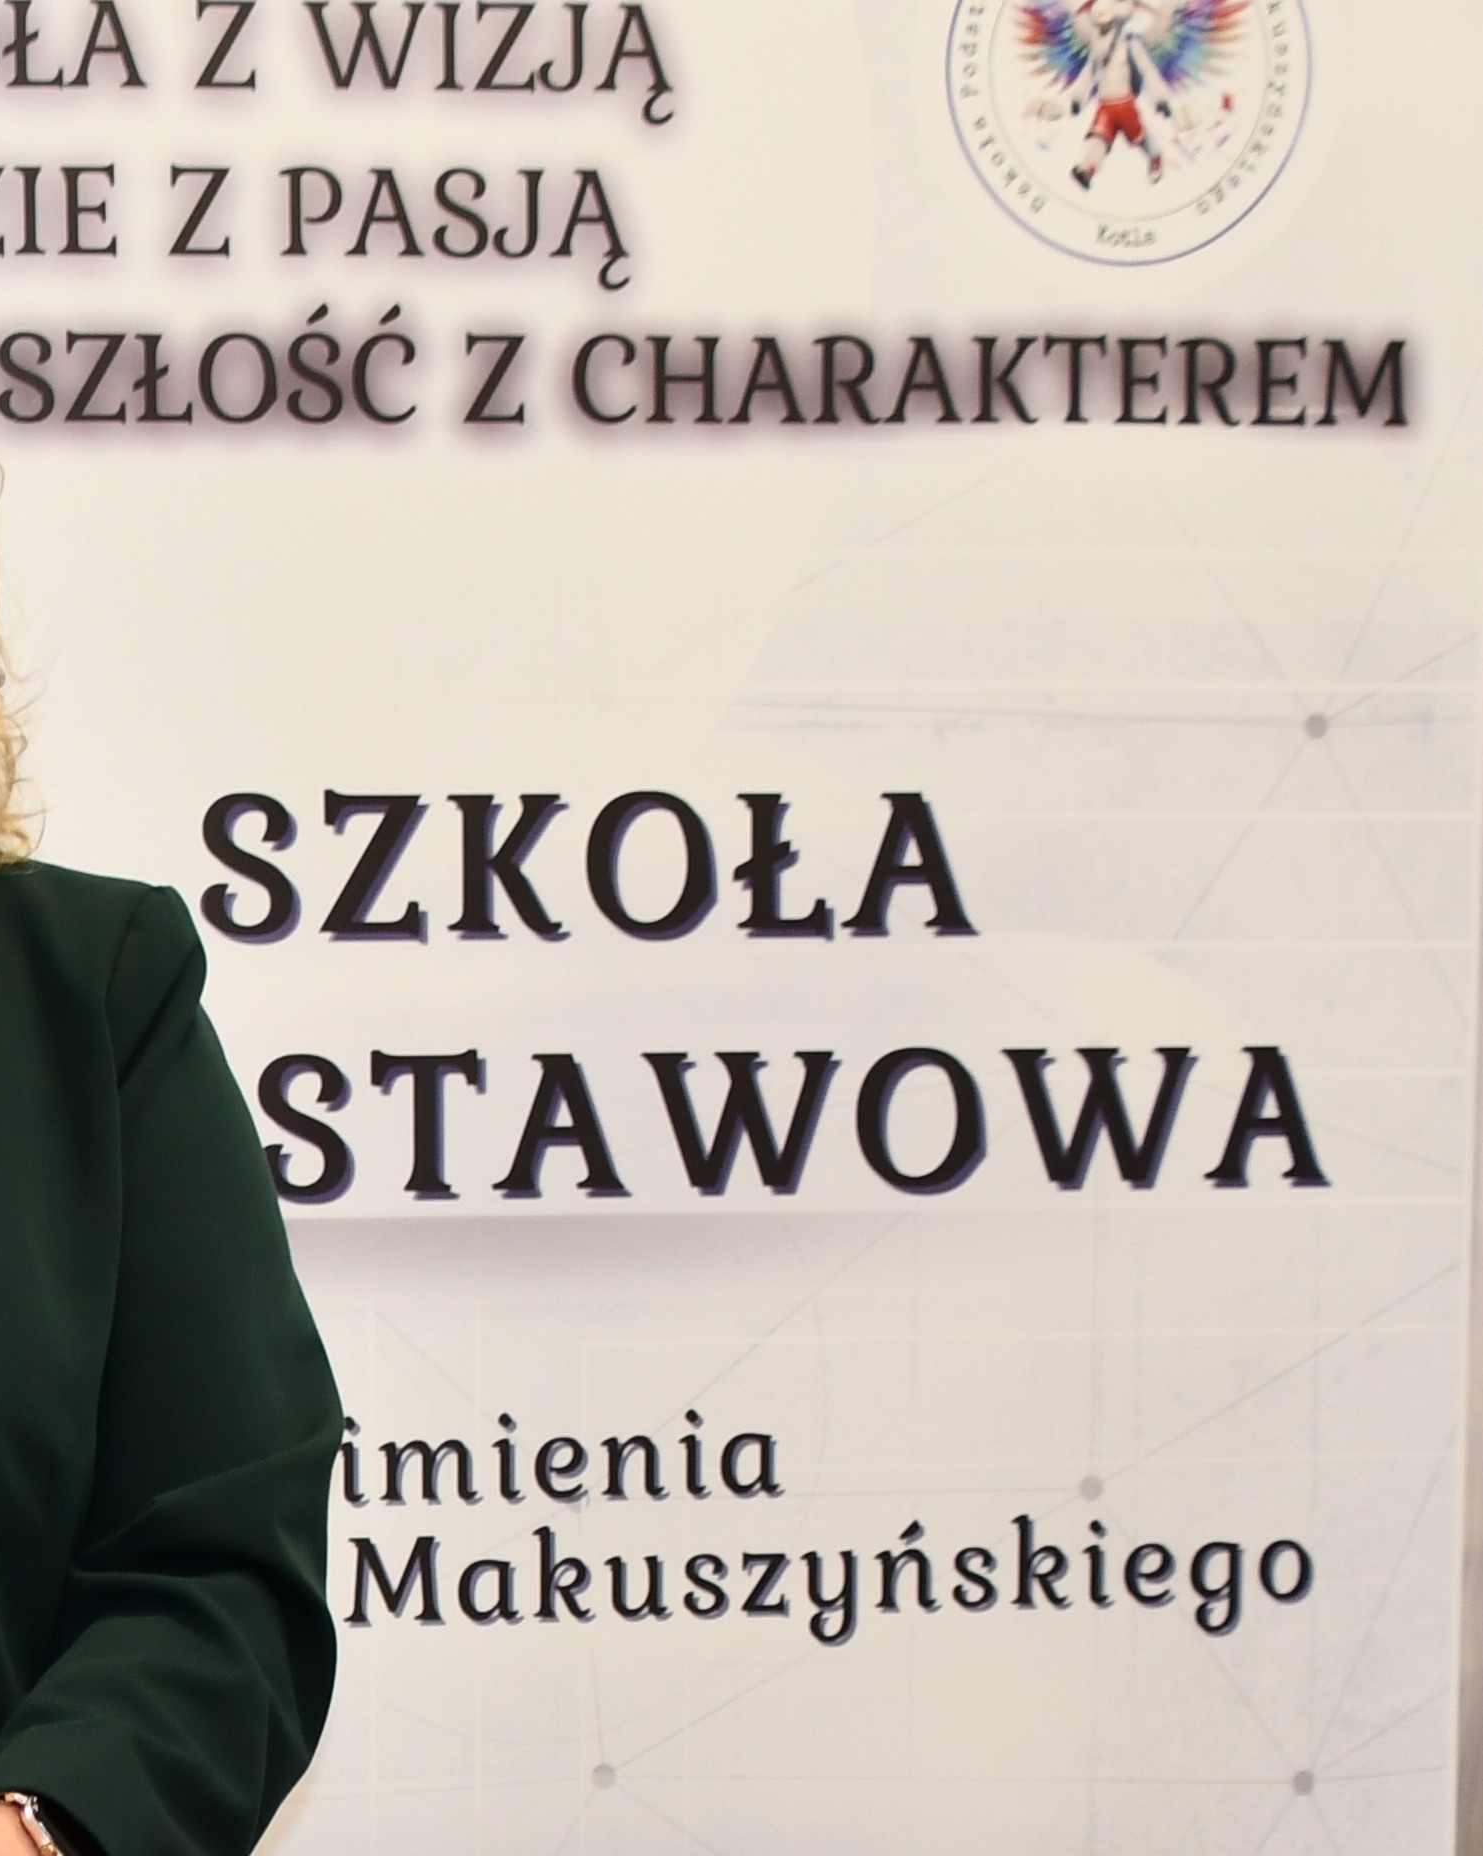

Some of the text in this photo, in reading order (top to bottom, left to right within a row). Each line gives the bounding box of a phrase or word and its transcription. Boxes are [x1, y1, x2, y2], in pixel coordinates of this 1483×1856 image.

[195, 0, 256, 91] Z
[302, 0, 674, 125] WIZJĄ
[169, 164, 231, 258] Z
[280, 164, 631, 291] PASJĄ
[463, 333, 526, 425] Z
[571, 331, 1410, 427] CHARAKTEREM
[200, 790, 979, 944] SZKOŁA
[256, 1045, 1331, 1203] STAWOWA
[338, 1409, 782, 1505] imienia
[346, 1514, 1313, 1648] Makuszyńskiego
